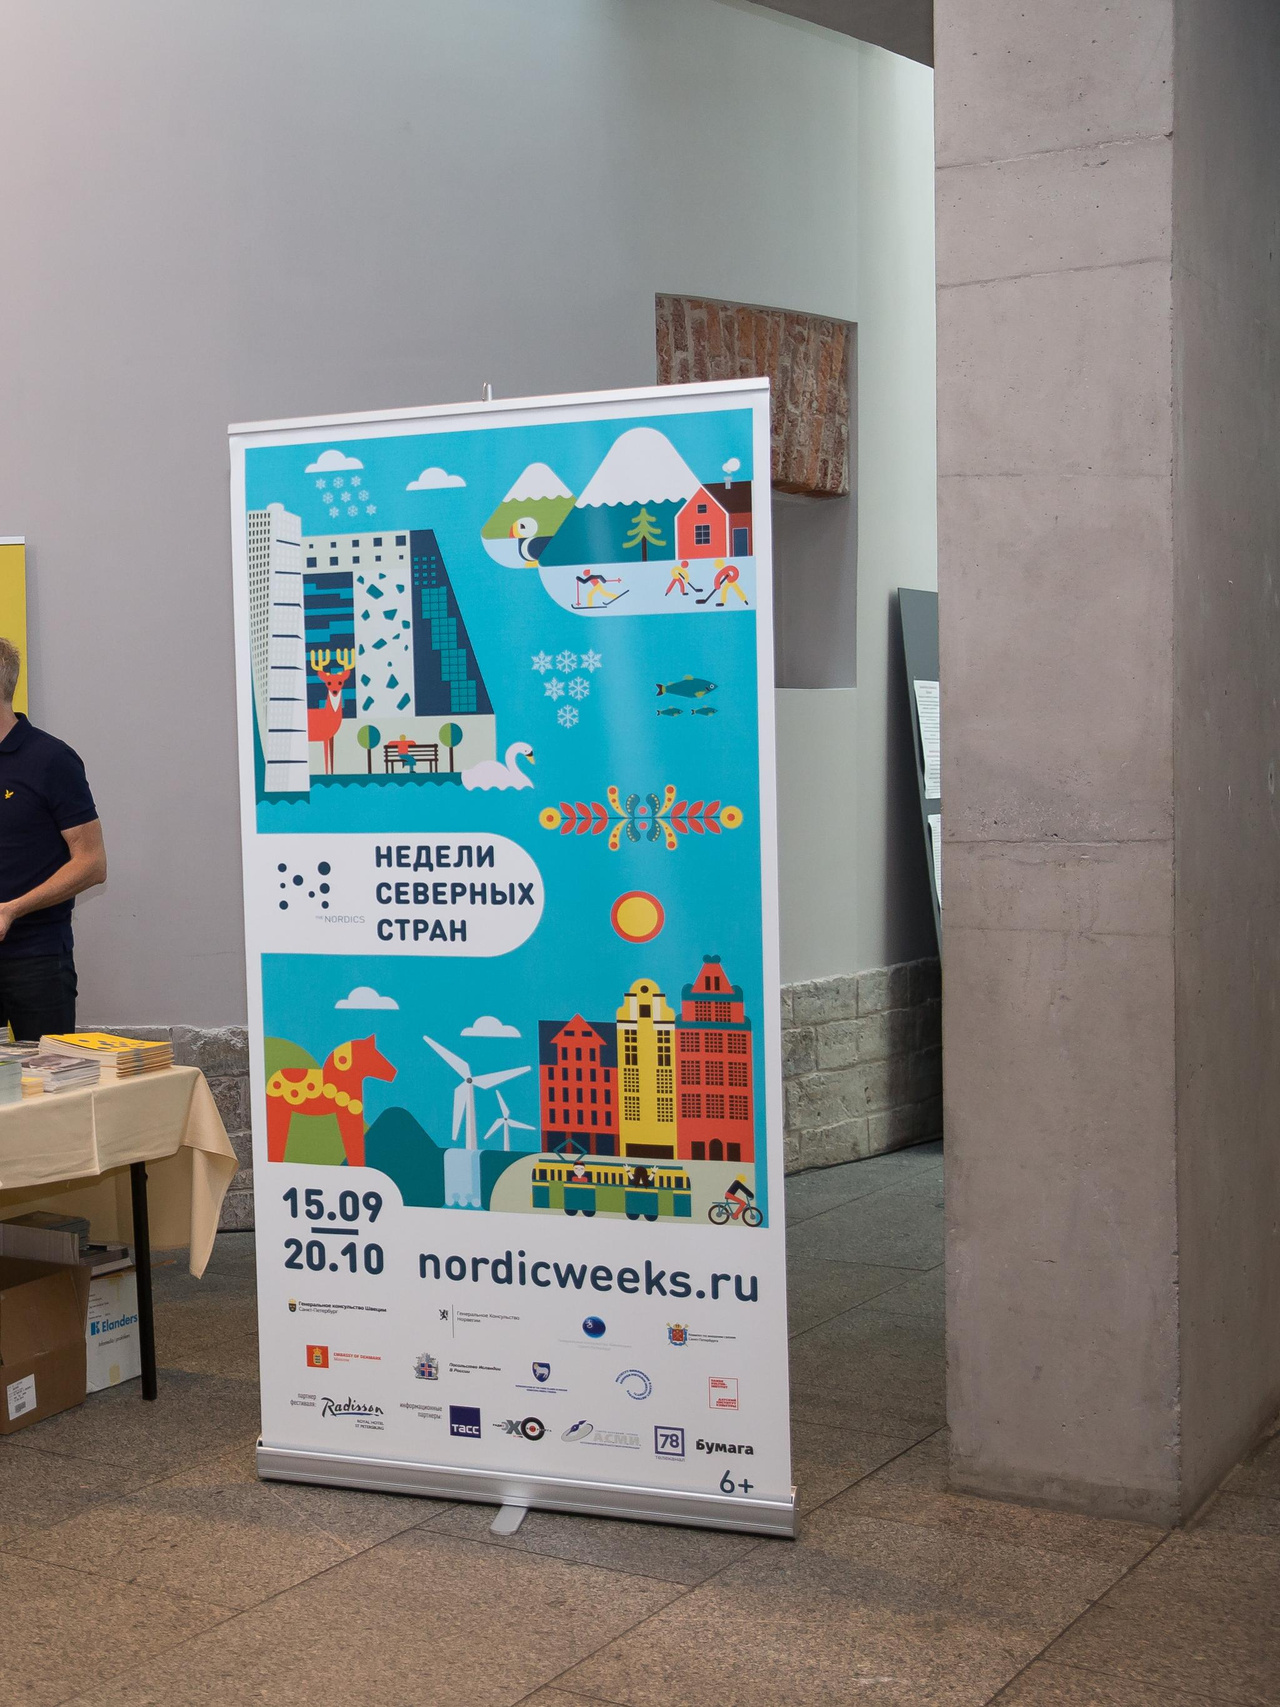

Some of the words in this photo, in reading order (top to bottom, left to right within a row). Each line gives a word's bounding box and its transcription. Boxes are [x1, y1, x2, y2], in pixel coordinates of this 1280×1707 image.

[375, 845, 495, 872] НЕДЕЛИ
[376, 882, 535, 906] СЕВЕРНЫХ
[324, 915, 366, 924] NORDICS
[377, 918, 467, 942] СТРАН
[282, 1187, 383, 1223] 15.09
[284, 1238, 384, 1275] 20.10
[419, 1250, 758, 1302] nordicweeks.ru
[101, 1314, 138, 1333] Elanders
[321, 1396, 384, 1418] Radisson
[400, 1402, 442, 1412] информационные
[659, 1433, 680, 1449] 78
[720, 1469, 754, 1494] 6+
